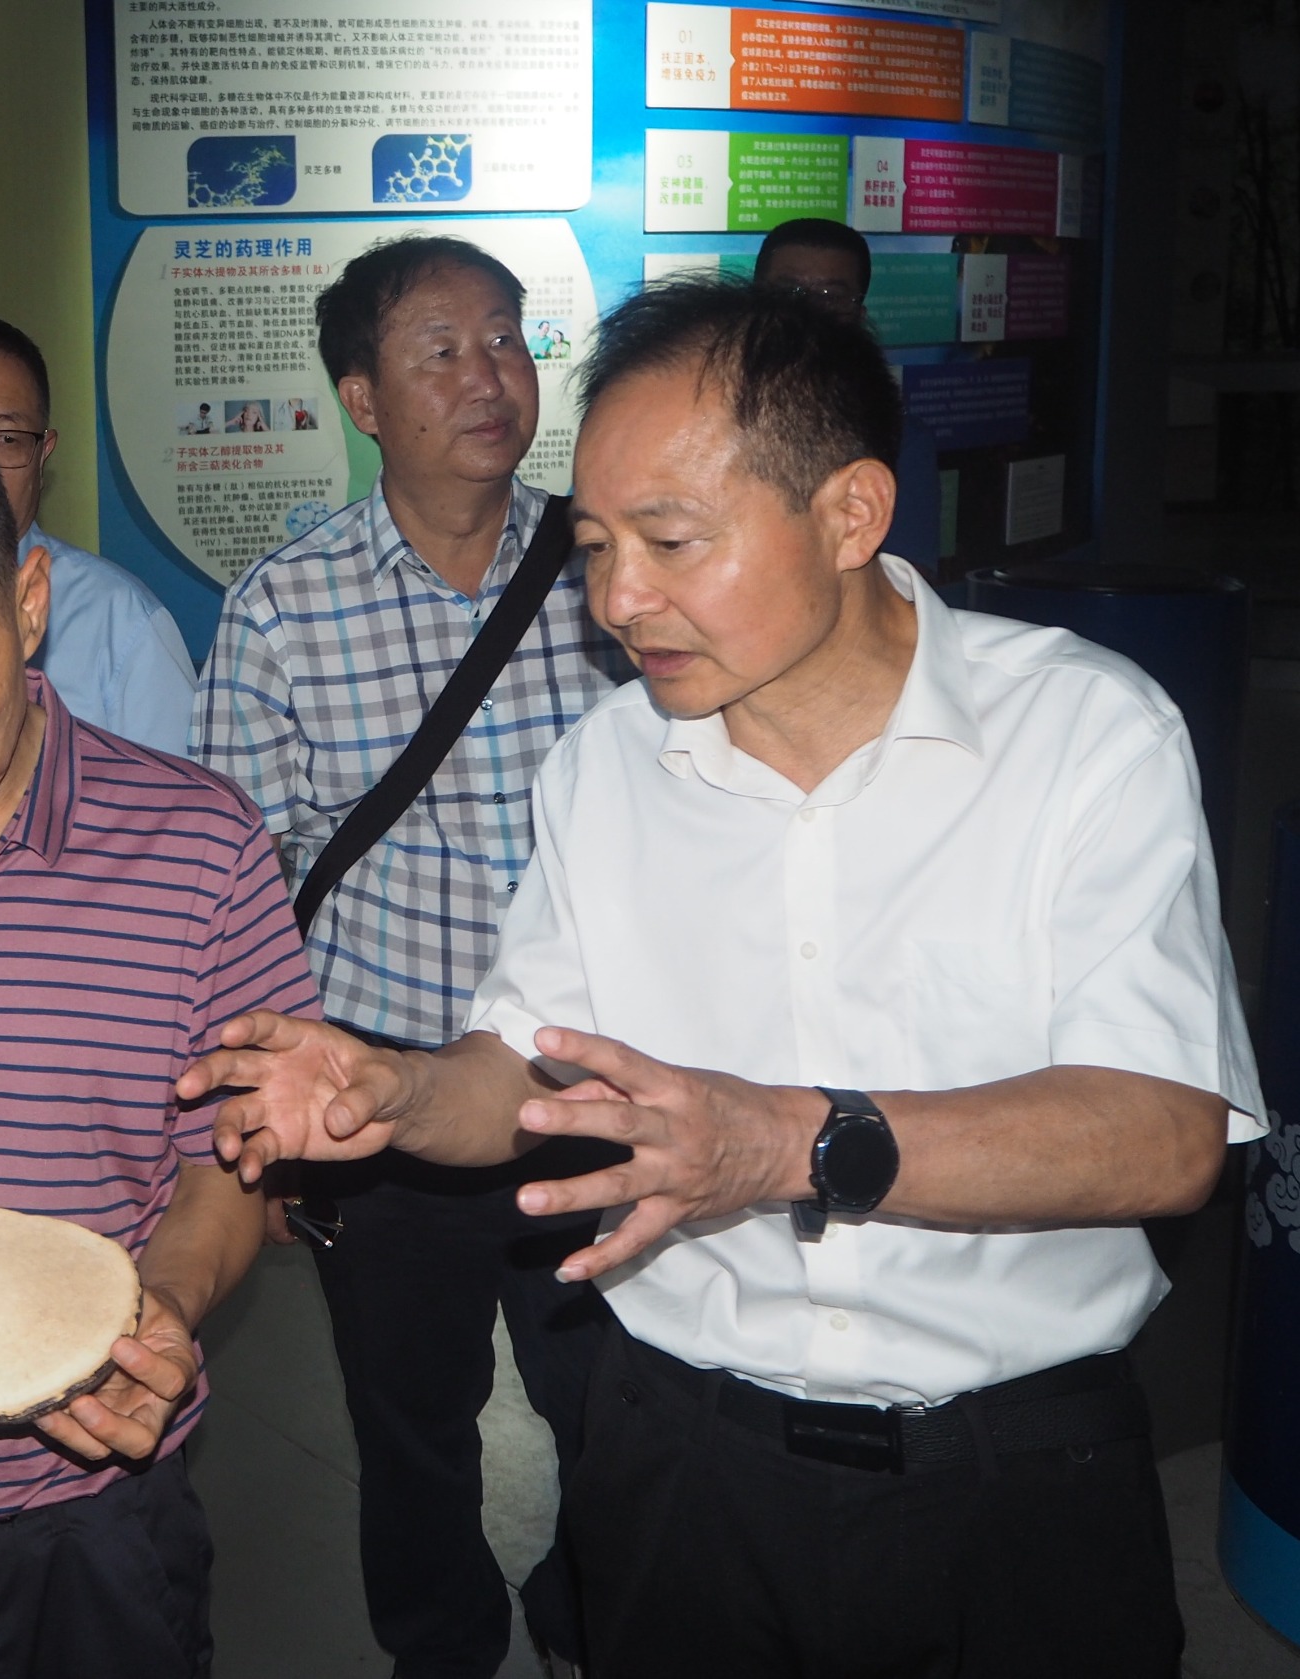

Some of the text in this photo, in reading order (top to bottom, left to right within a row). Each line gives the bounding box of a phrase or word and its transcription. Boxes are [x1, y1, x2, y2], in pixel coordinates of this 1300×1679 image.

[129, 1, 221, 12] 主要的两大活性成分。
[679, 30, 692, 44] 01
[661, 68, 716, 82] 增强免疫力
[304, 164, 342, 175] 灵芝多糖
[877, 160, 888, 173] 04
[659, 192, 704, 205] 改善睡眠
[174, 239, 312, 259] 灵芝的药理作用
[176, 444, 284, 458] 子实体乙醇提取物及其
[176, 458, 264, 472] 所含三萜类化合物
[193, 524, 269, 537] 获得性免疫缺陷病毒
